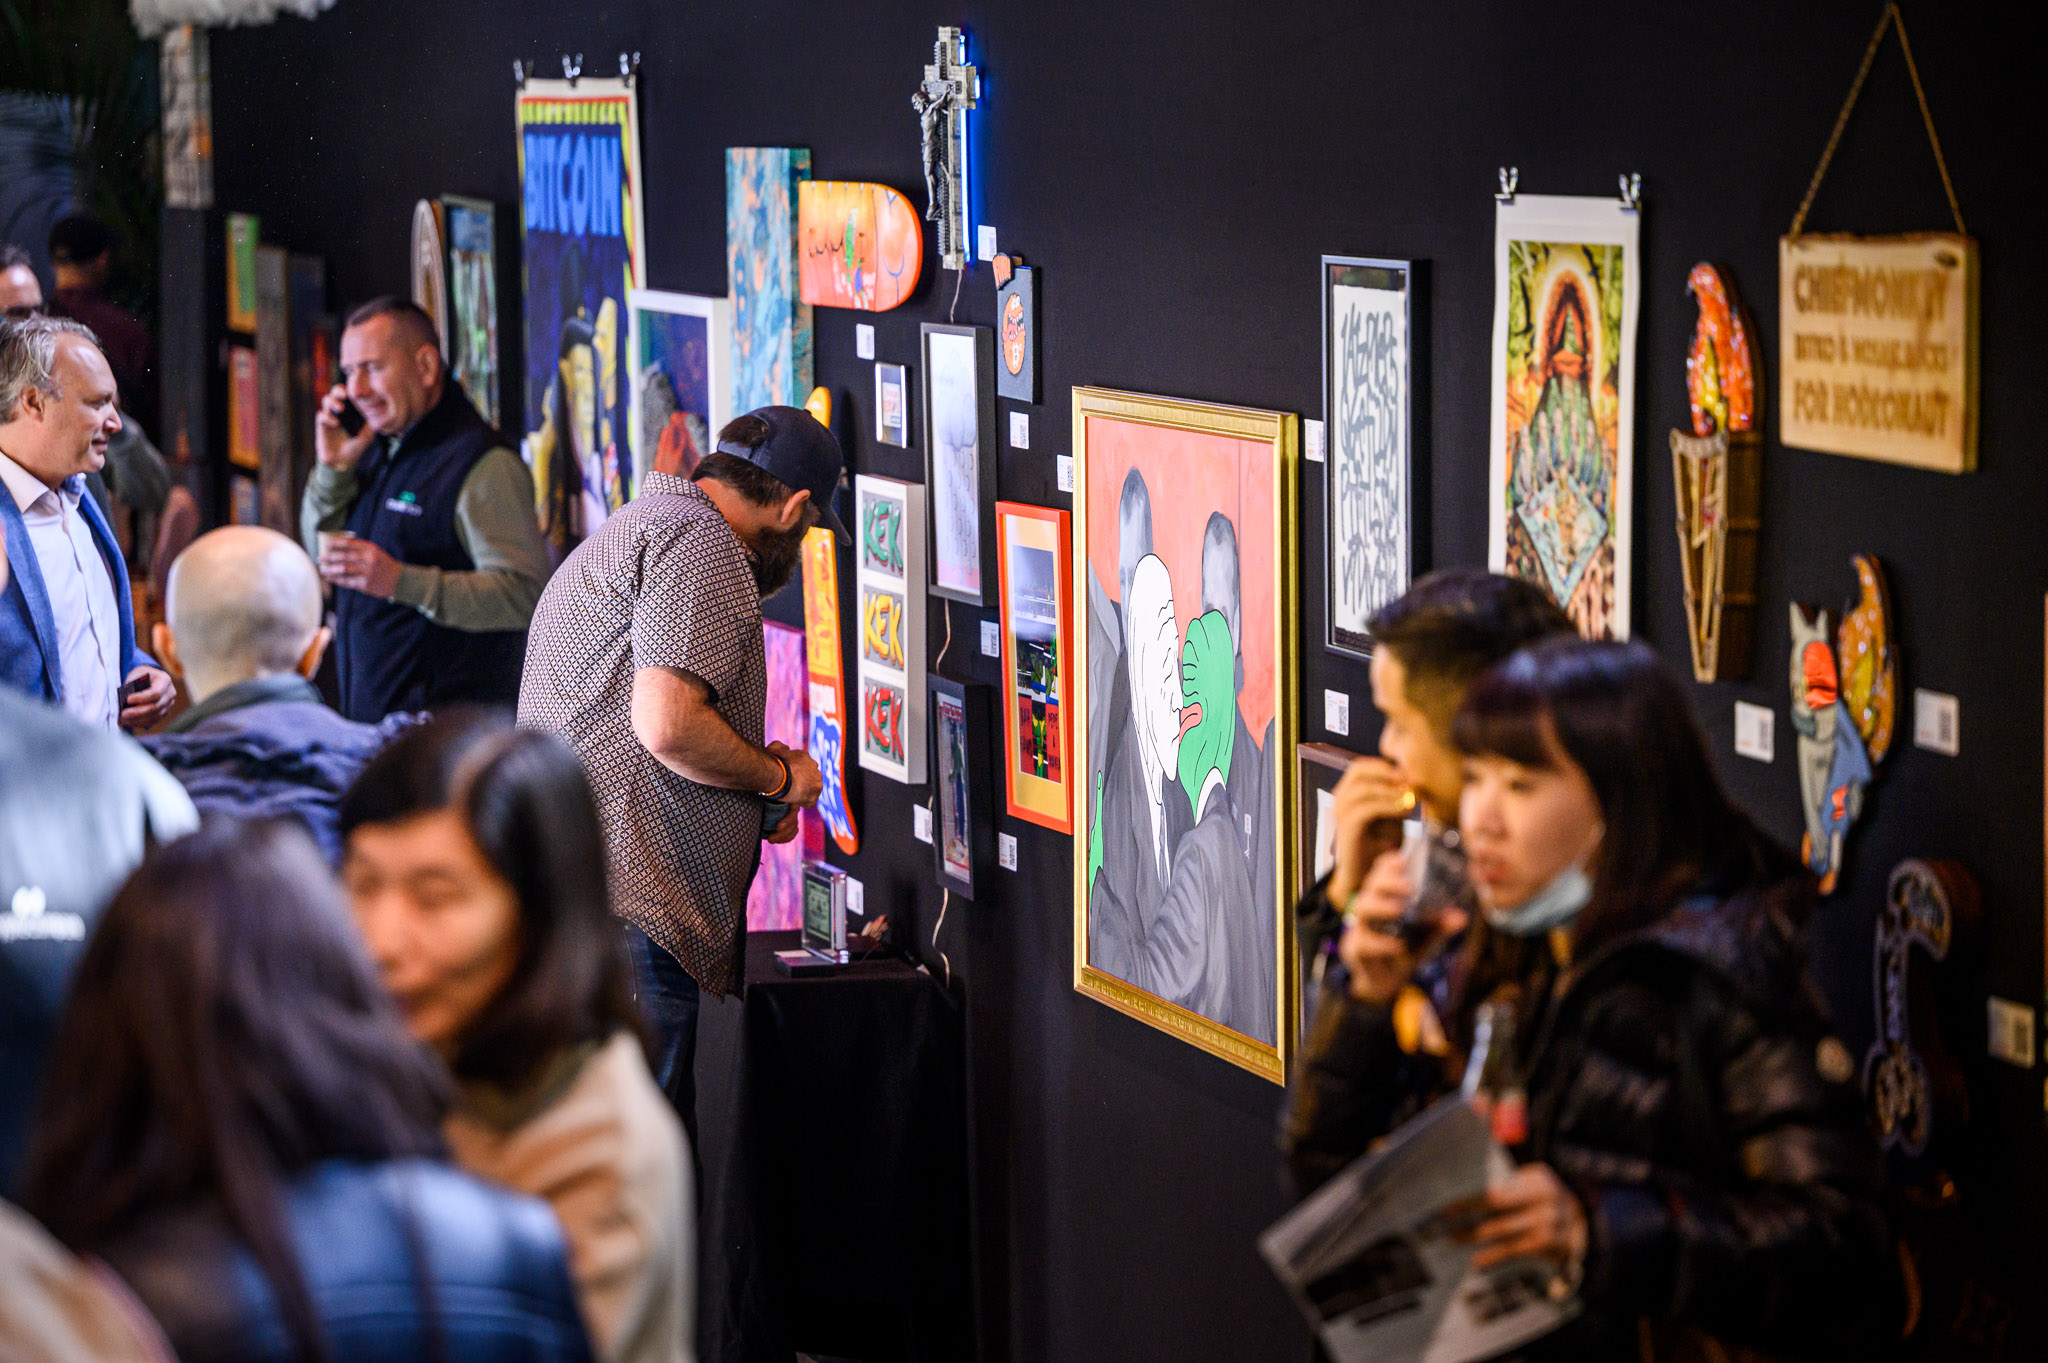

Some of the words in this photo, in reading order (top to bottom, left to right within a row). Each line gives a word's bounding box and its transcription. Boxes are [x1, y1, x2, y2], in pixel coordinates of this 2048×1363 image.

[524, 133, 622, 237] BITCOIN
[863, 501, 904, 576] KEK
[864, 592, 904, 670] KEK
[865, 685, 905, 766] KEK
